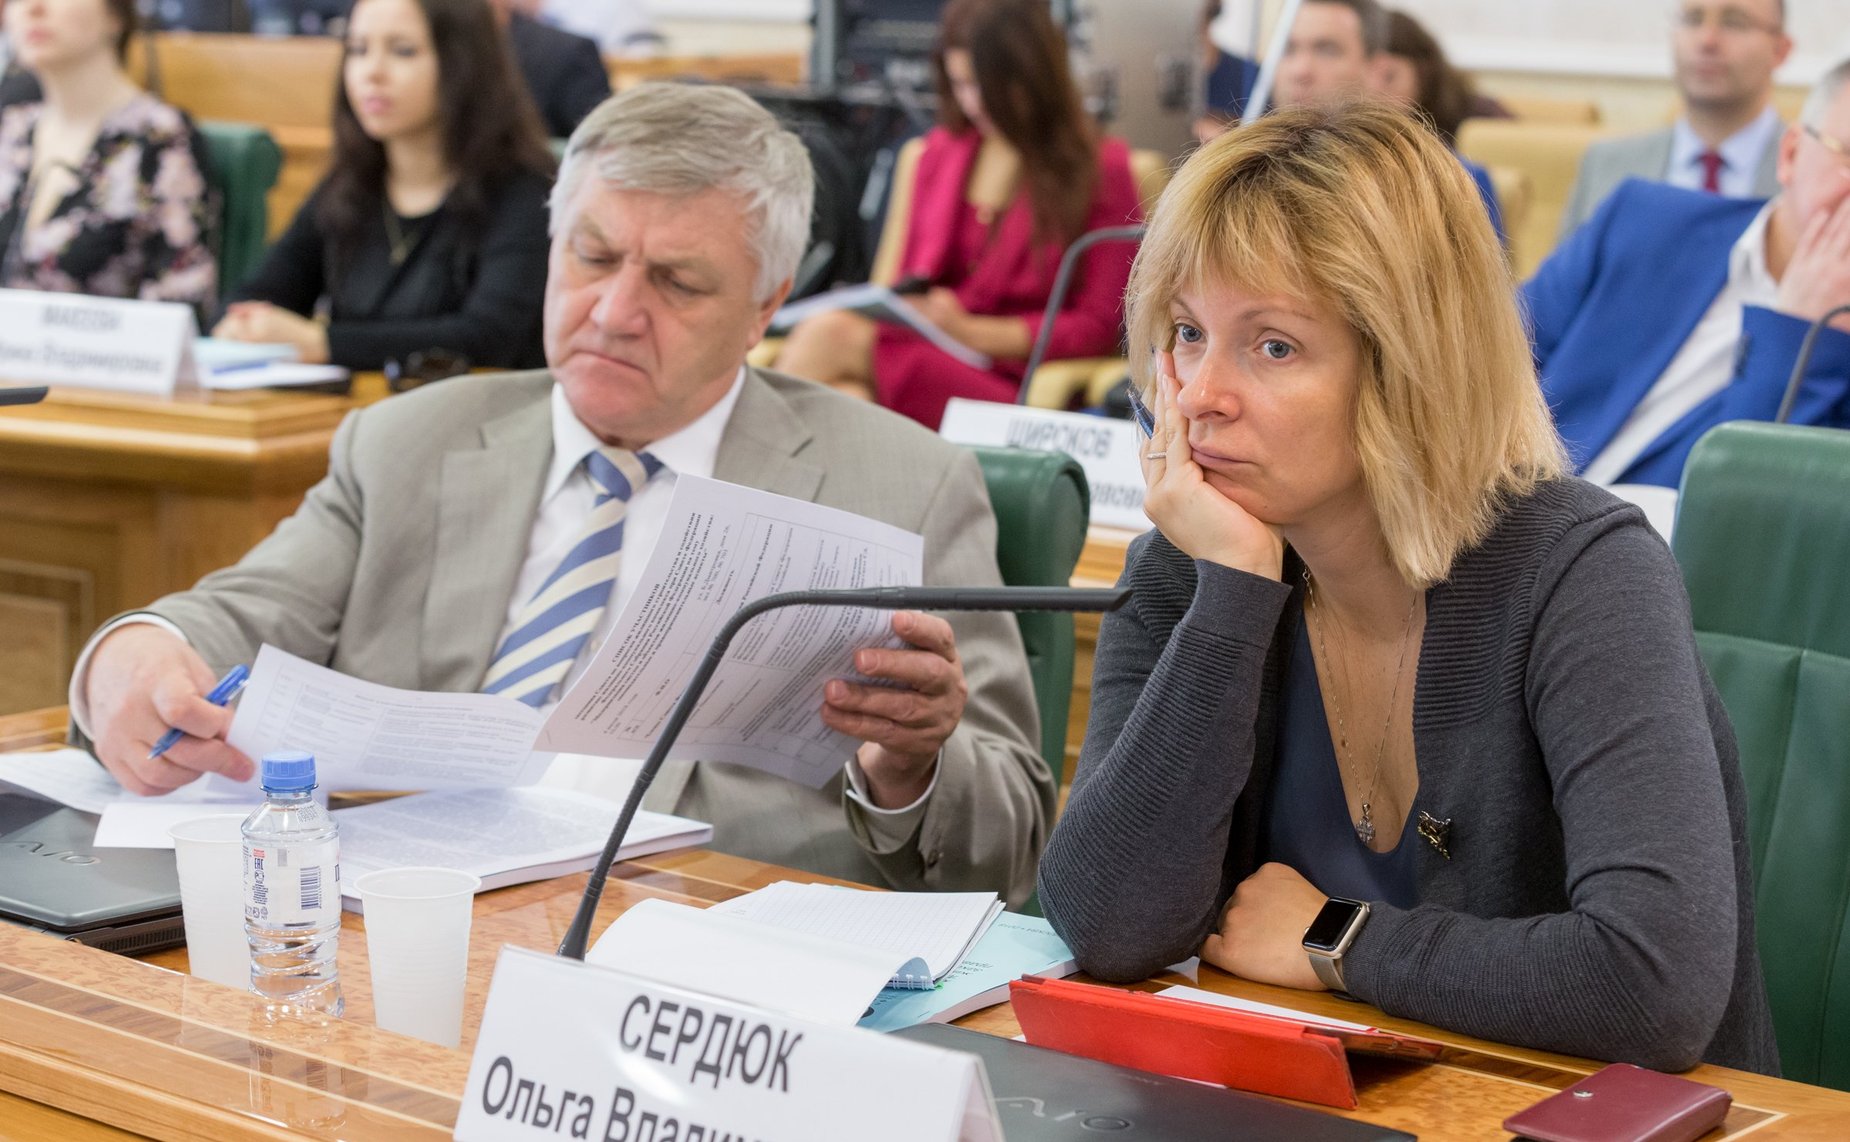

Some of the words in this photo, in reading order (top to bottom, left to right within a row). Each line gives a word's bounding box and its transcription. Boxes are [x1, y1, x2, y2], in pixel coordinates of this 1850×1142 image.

[618, 995, 804, 1092] СЕРДЮК
[482, 1056, 595, 1141] Ольга
[604, 1087, 760, 1142] Вла
